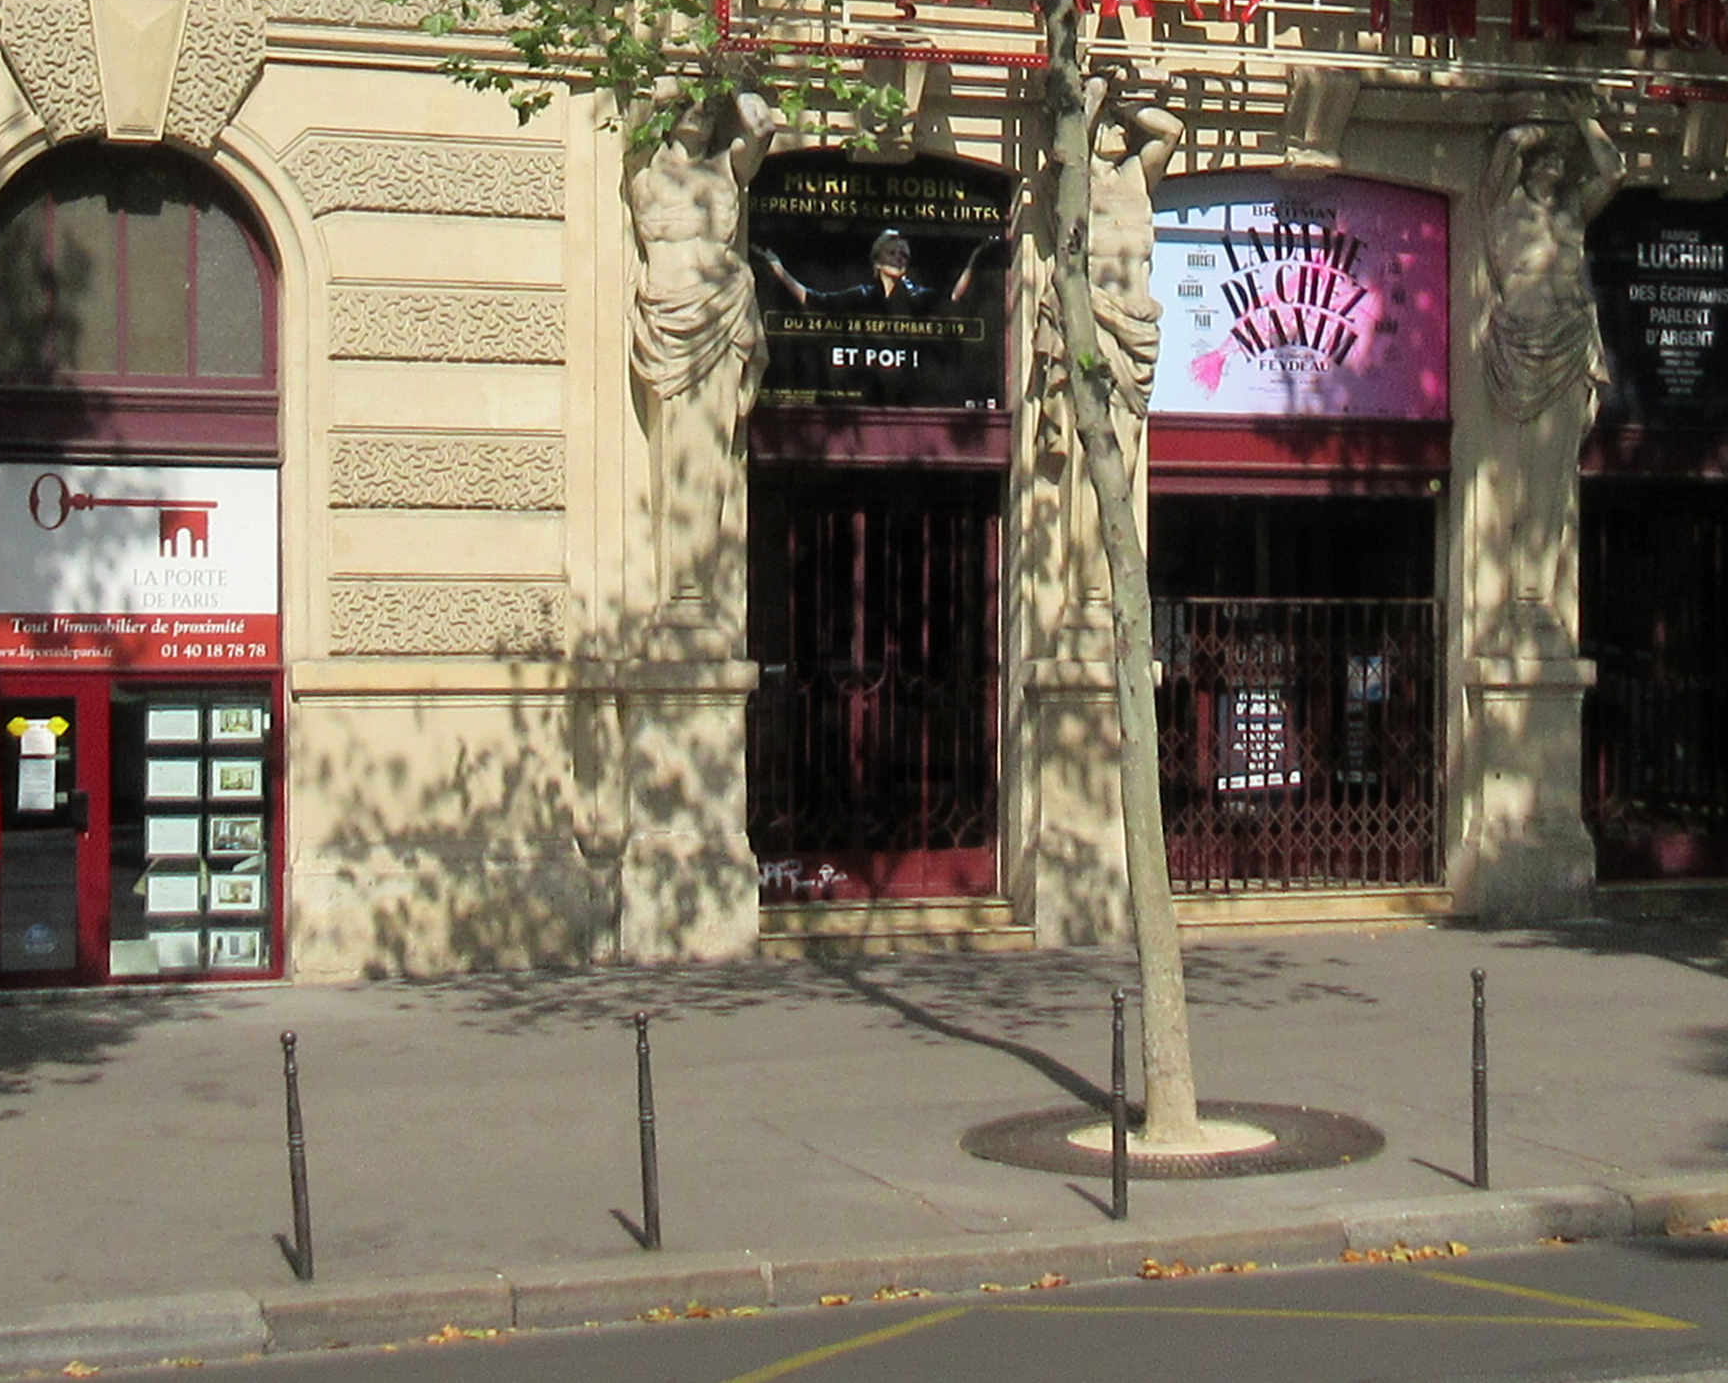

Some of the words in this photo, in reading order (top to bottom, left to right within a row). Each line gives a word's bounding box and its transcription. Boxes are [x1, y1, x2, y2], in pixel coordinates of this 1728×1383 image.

[784, 171, 878, 196] MURIEL
[887, 176, 967, 201] ROBIN
[750, 196, 825, 215] REPREND
[830, 200, 858, 217] SES
[1221, 226, 1270, 273] LA
[1272, 222, 1369, 279] DAME
[1636, 243, 1726, 271] LUCHINI
[1219, 271, 1270, 320] DE
[1274, 263, 1369, 324] CHEZ
[1628, 285, 1657, 303] DES
[783, 317, 804, 330] DU
[824, 318, 844, 331] AU
[864, 319, 933, 333] SEPTEMBRE
[1649, 308, 1712, 327] PARLENT
[1231, 307, 1360, 366] MAXIM
[1645, 329, 1715, 348] D'ARGENT
[831, 347, 859, 366] ET
[865, 348, 906, 368] POF
[1258, 358, 1331, 374] FEYDEAU
[132, 568, 159, 587] LA
[163, 568, 228, 588] PORTE
[142, 592, 167, 608] DE
[170, 592, 219, 609] PARIS
[10, 617, 48, 635] Tout
[52, 617, 148, 635] l'immobilier
[150, 618, 170, 635] de
[172, 617, 246, 638] proximité
[160, 644, 179, 658] 01
[182, 644, 203, 659] 40
[205, 644, 223, 659] 18
[226, 644, 246, 659] 78
[248, 644, 267, 659] 78
